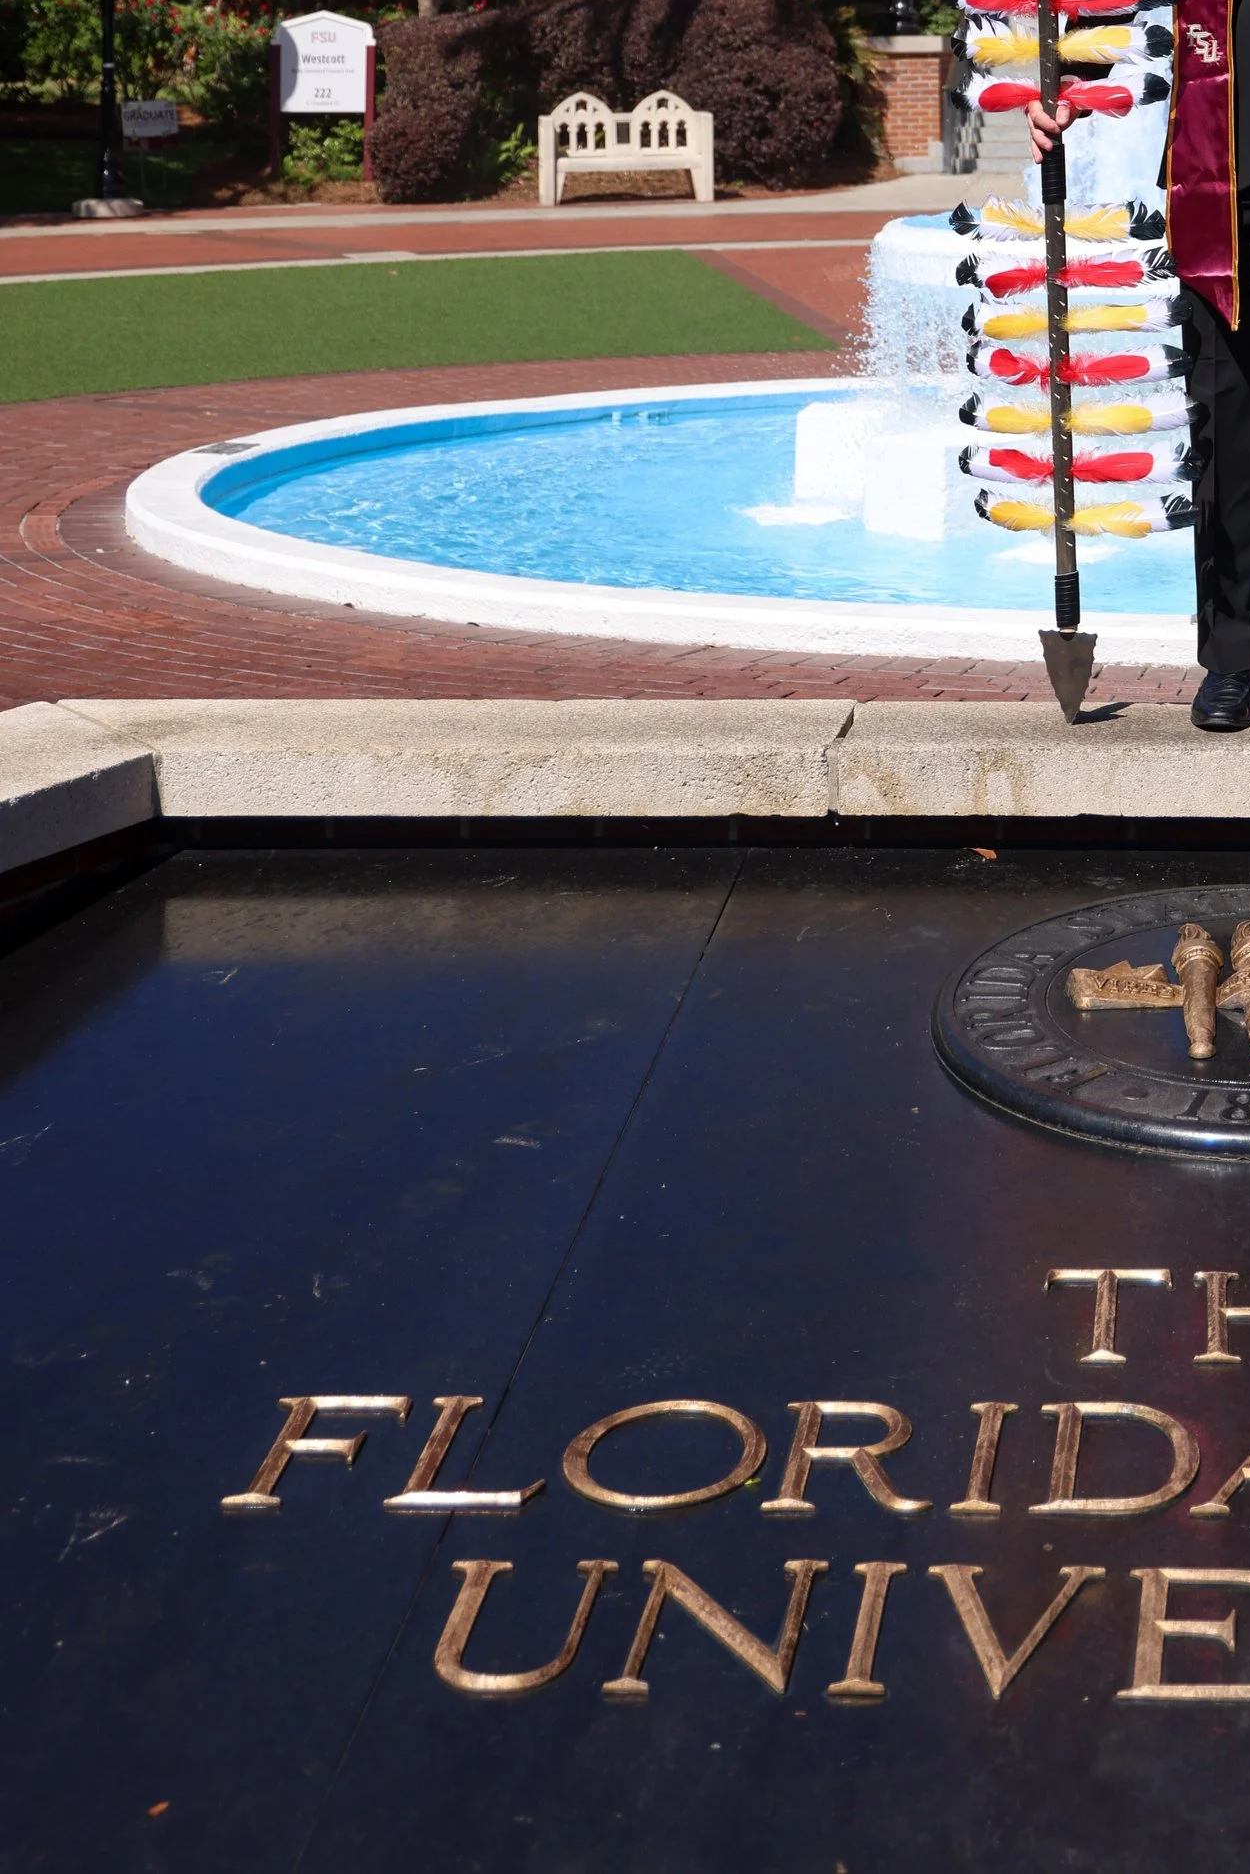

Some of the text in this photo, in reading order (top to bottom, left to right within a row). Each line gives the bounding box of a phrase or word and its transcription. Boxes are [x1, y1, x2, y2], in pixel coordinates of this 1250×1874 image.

[310, 31, 336, 44] FSU
[1186, 23, 1221, 63] FSU
[301, 53, 345, 64] Westcott
[314, 87, 331, 98] 222
[1091, 975, 1173, 998] VIRES
[961, 949, 1110, 1095] FLORIDA
